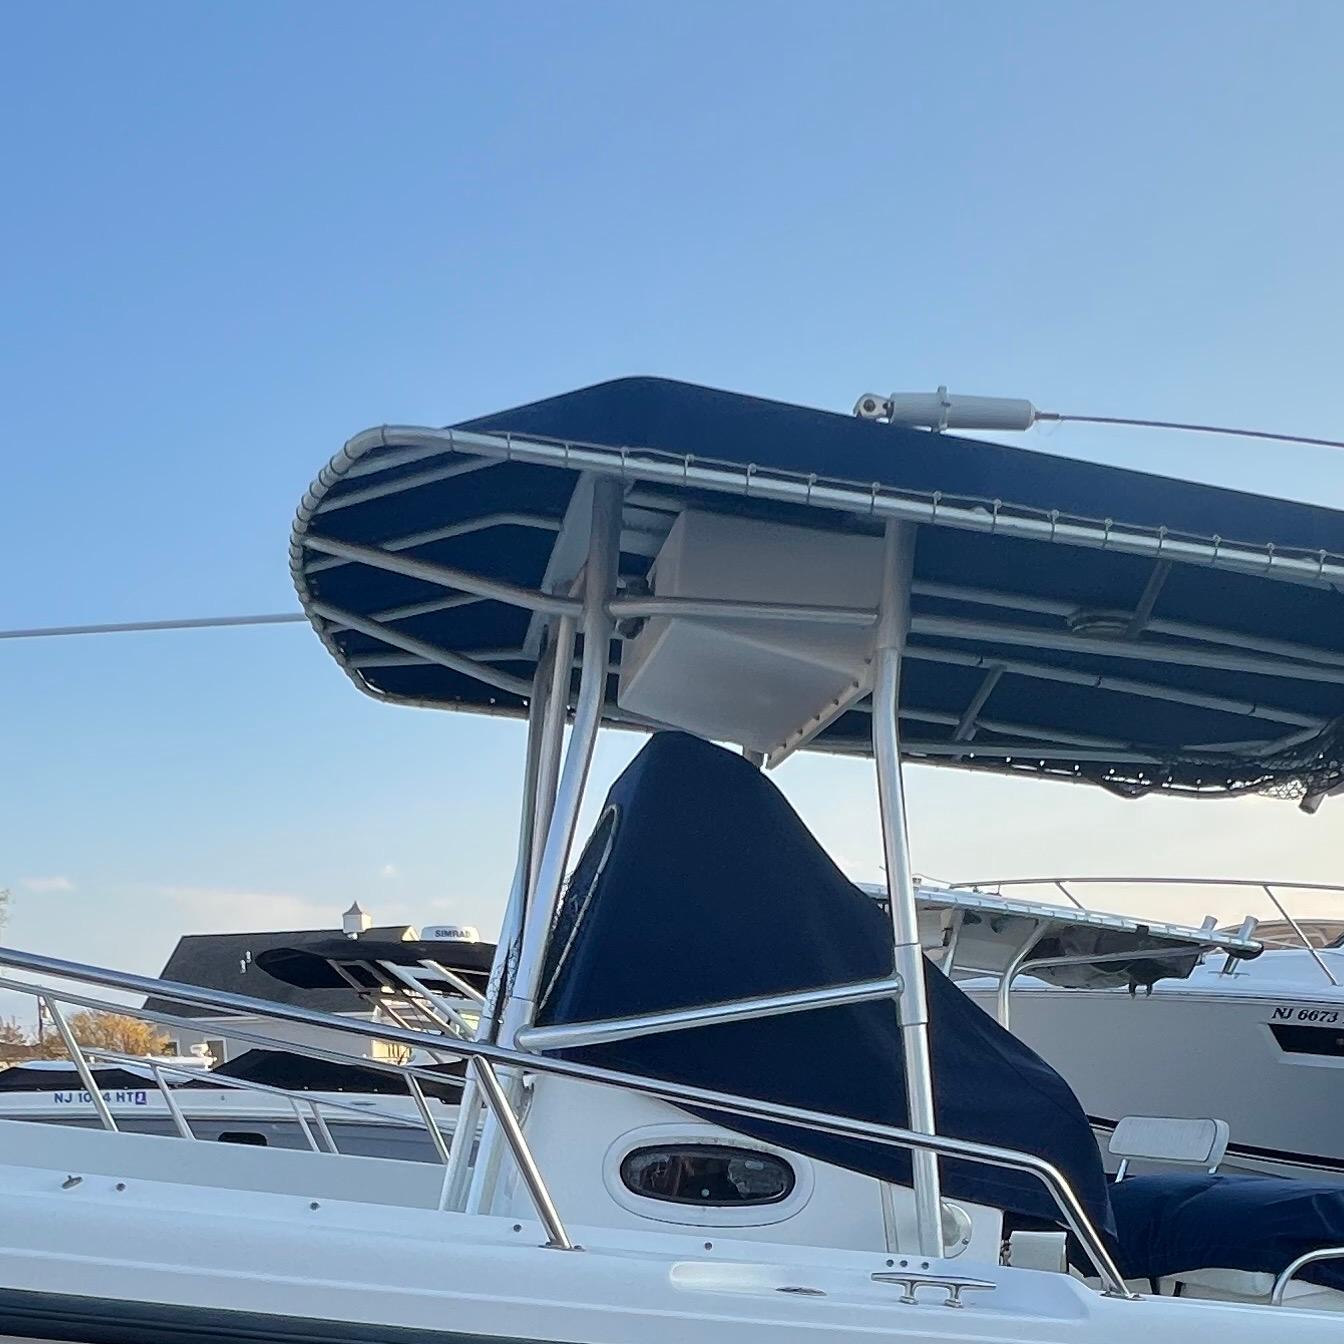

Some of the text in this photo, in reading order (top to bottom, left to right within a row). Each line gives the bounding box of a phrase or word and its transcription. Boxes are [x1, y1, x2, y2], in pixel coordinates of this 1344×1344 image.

[434, 929, 471, 938] SIMRAD
[1272, 1007, 1294, 1019] NJ
[1297, 1009, 1338, 1023] 6673
[54, 1092, 134, 1103] NJ 104 HT
